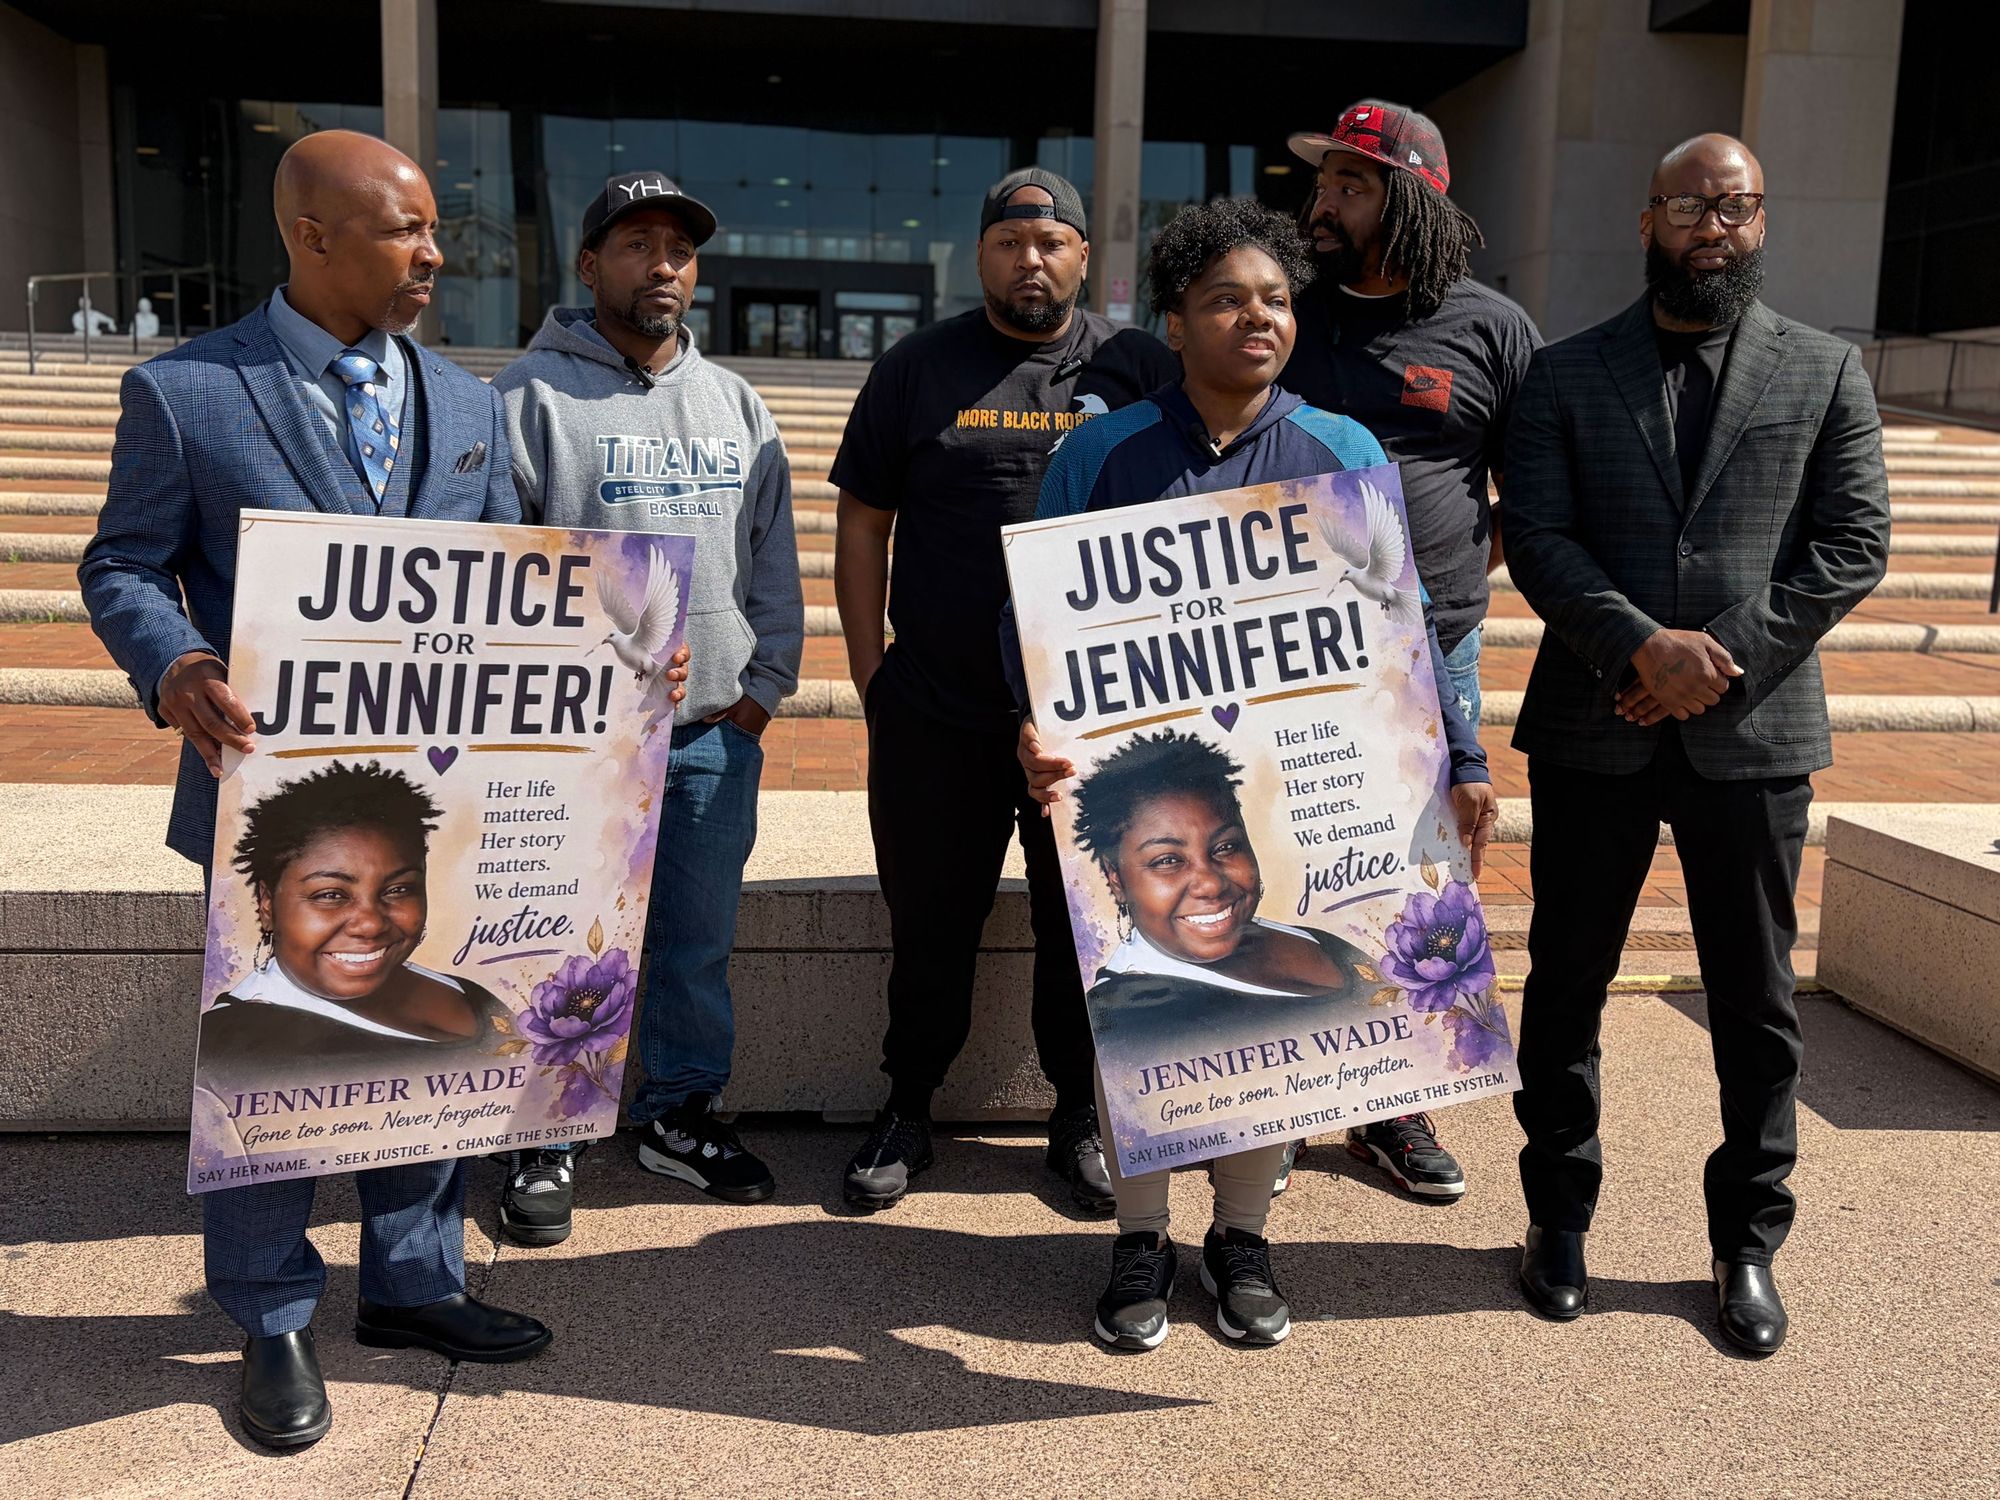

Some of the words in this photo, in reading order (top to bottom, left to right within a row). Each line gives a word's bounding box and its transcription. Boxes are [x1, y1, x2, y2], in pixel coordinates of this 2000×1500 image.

[957, 409, 998, 428] MORE
[1003, 410, 1050, 431] BLACK
[1055, 412, 1097, 432] ROB
[596, 434, 742, 477] TITANS
[615, 486, 644, 494] STEEL
[649, 501, 722, 517] BASEBALL
[1065, 503, 1318, 611] JUSTICE
[298, 543, 591, 628] JUSTICE
[1170, 596, 1226, 624] FOR
[412, 632, 475, 655] FOR
[1053, 601, 1370, 722] JENNIFER!
[250, 660, 614, 736] JENNIFER!
[1274, 729, 1307, 747] Her
[1312, 721, 1339, 741] life
[1280, 742, 1362, 771] mattered.
[486, 782, 522, 798] Her
[527, 780, 555, 797] life
[1285, 780, 1318, 797] Her
[1323, 772, 1365, 791] story
[483, 804, 569, 823] mattered.
[1290, 798, 1360, 822] matters.
[480, 833, 515, 849] Her
[520, 834, 565, 850] story
[1294, 830, 1323, 847] We
[1327, 814, 1396, 842] demand
[477, 858, 550, 874] matters.
[1297, 846, 1405, 916] justice.
[475, 884, 502, 900] We
[508, 879, 579, 897] demand
[453, 905, 574, 965] justice.
[1137, 1038, 1304, 1095] JENNIFER
[1310, 1014, 1413, 1057] WADE
[227, 1078, 411, 1118] JENNIFER
[424, 1065, 526, 1098] WADE
[1160, 1100, 1203, 1124] Gone
[1208, 1095, 1234, 1111] too
[1238, 1087, 1278, 1105] soon.
[1336, 1054, 1414, 1090] forgotten.
[244, 1125, 292, 1147] Gone
[298, 1120, 326, 1139] too
[329, 1119, 373, 1135] soon.
[433, 1101, 515, 1128] forgotten.
[1128, 1148, 1154, 1165] SAY
[1156, 1142, 1185, 1160] HER
[1188, 1132, 1232, 1151] NAME.
[1253, 1120, 1286, 1137] SEEK
[1289, 1106, 1347, 1130] JUSTICE.
[1366, 1092, 1422, 1113] CHANGE
[1422, 1084, 1452, 1102] THE
[1453, 1072, 1508, 1094] SYSTEM.
[197, 1169, 227, 1184] SAY
[230, 1164, 260, 1179] HER
[264, 1158, 311, 1174] NAME.
[335, 1152, 370, 1166] SEEK
[374, 1144, 434, 1162] JUSTICE.
[456, 1135, 514, 1151] CHANGE
[516, 1130, 542, 1143] THE
[543, 1121, 598, 1140] SYSTEM.
